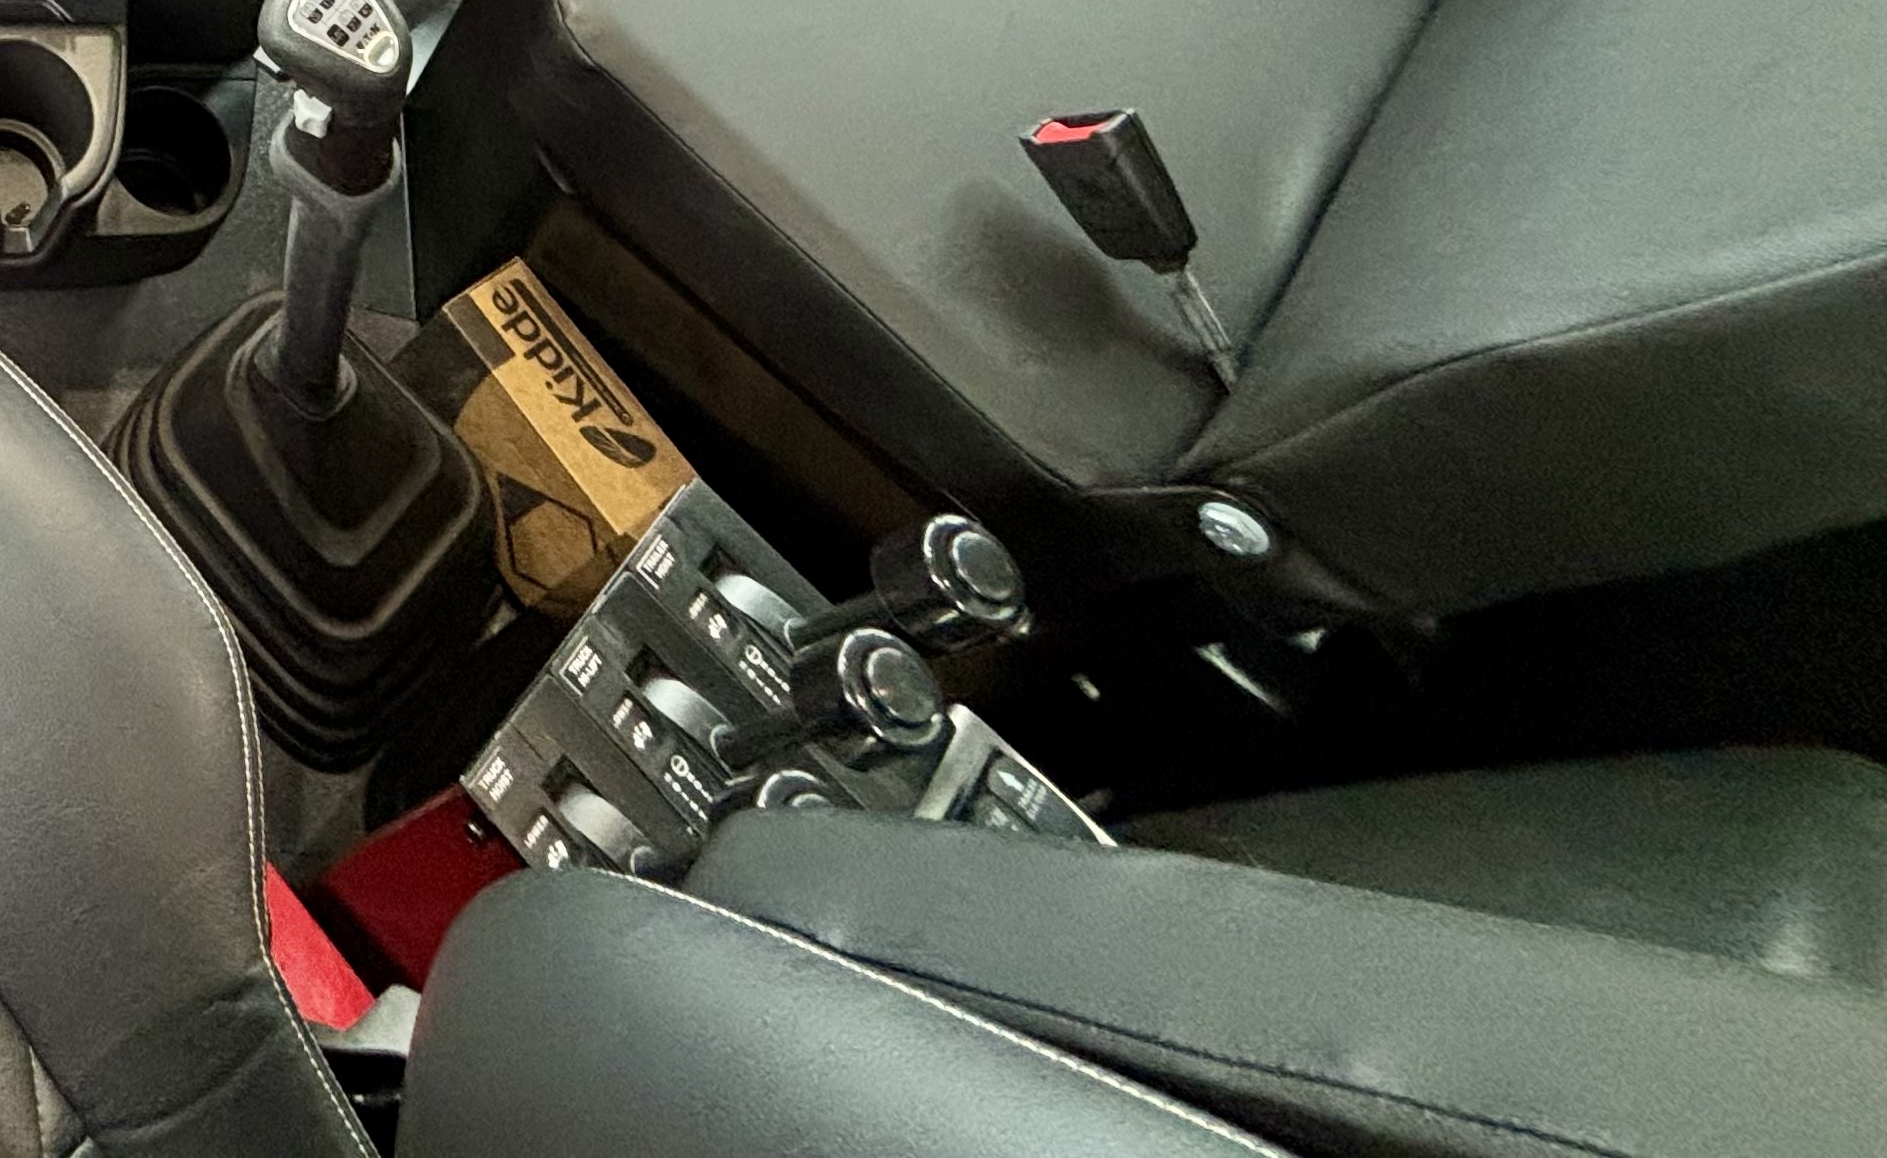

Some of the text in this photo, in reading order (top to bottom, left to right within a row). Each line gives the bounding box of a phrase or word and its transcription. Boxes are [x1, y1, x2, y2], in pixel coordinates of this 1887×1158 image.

[492, 286, 602, 423] Kidde
[643, 539, 669, 573] TRAILER
[568, 645, 593, 676] TRUCK
[478, 756, 505, 789] TRUCK
[489, 767, 514, 803] HOIST
[525, 814, 549, 849] LOWER
